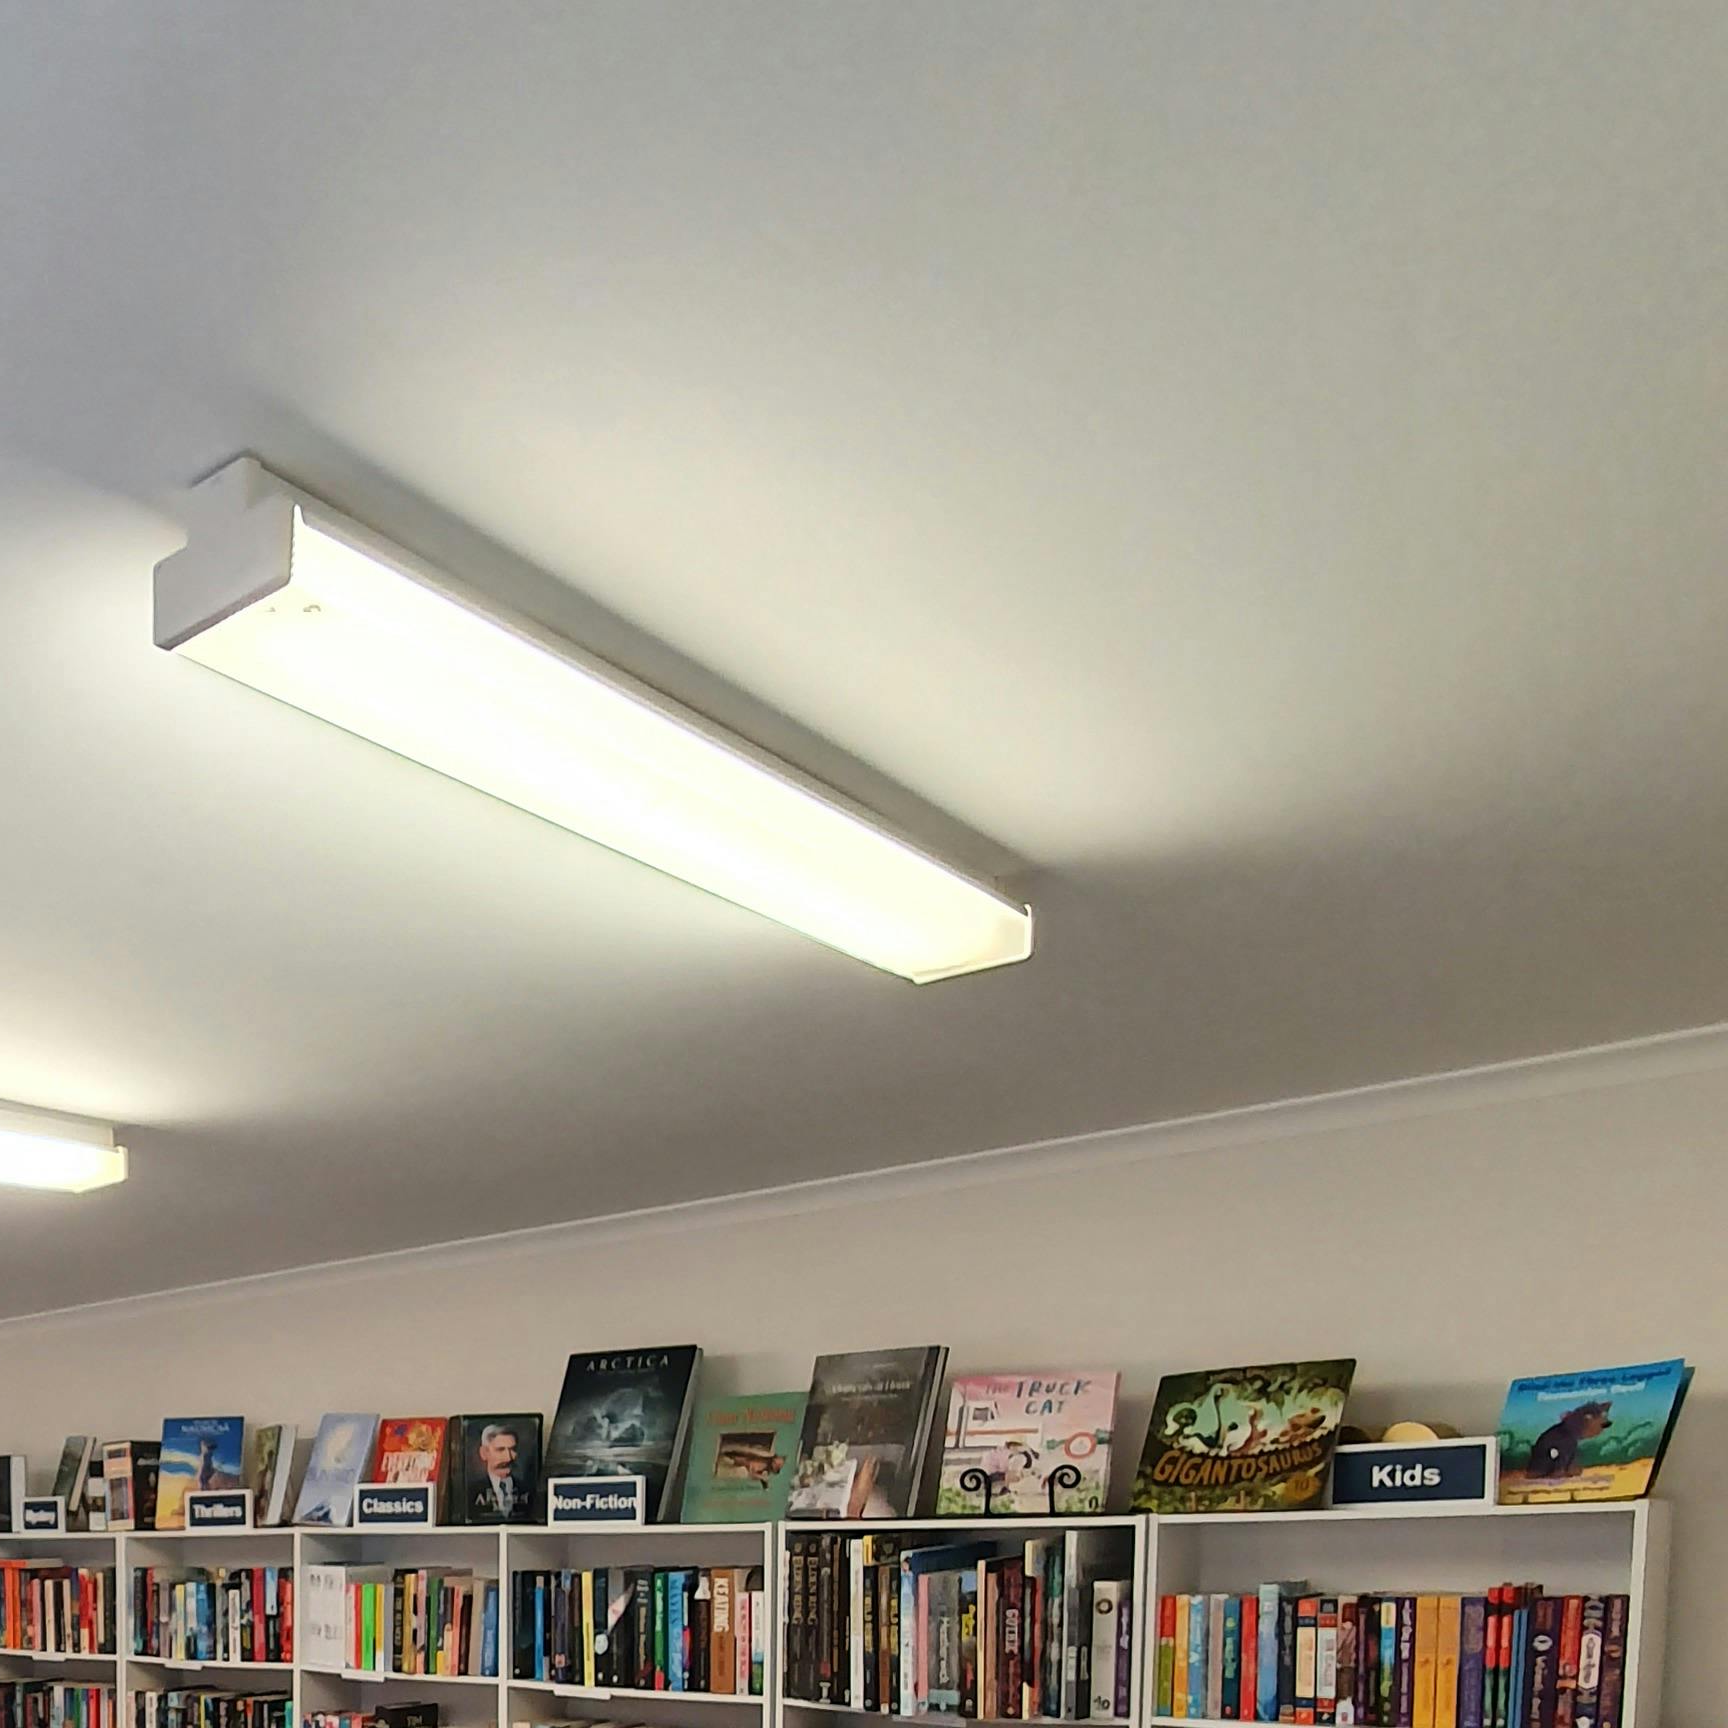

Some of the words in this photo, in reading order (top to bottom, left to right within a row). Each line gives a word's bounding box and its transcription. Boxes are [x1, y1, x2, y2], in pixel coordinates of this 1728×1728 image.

[586, 1354, 669, 1372] ARCTICA
[1016, 1380, 1092, 1397] TRUCK
[1025, 1399, 1065, 1415] CAT
[1152, 1444, 1322, 1486] GIGANTOSAURUS
[1372, 1464, 1442, 1488] Kids
[362, 1498, 424, 1514] Classics
[553, 1493, 638, 1510] Non-Fiction
[714, 1577, 730, 1633] KEATING
